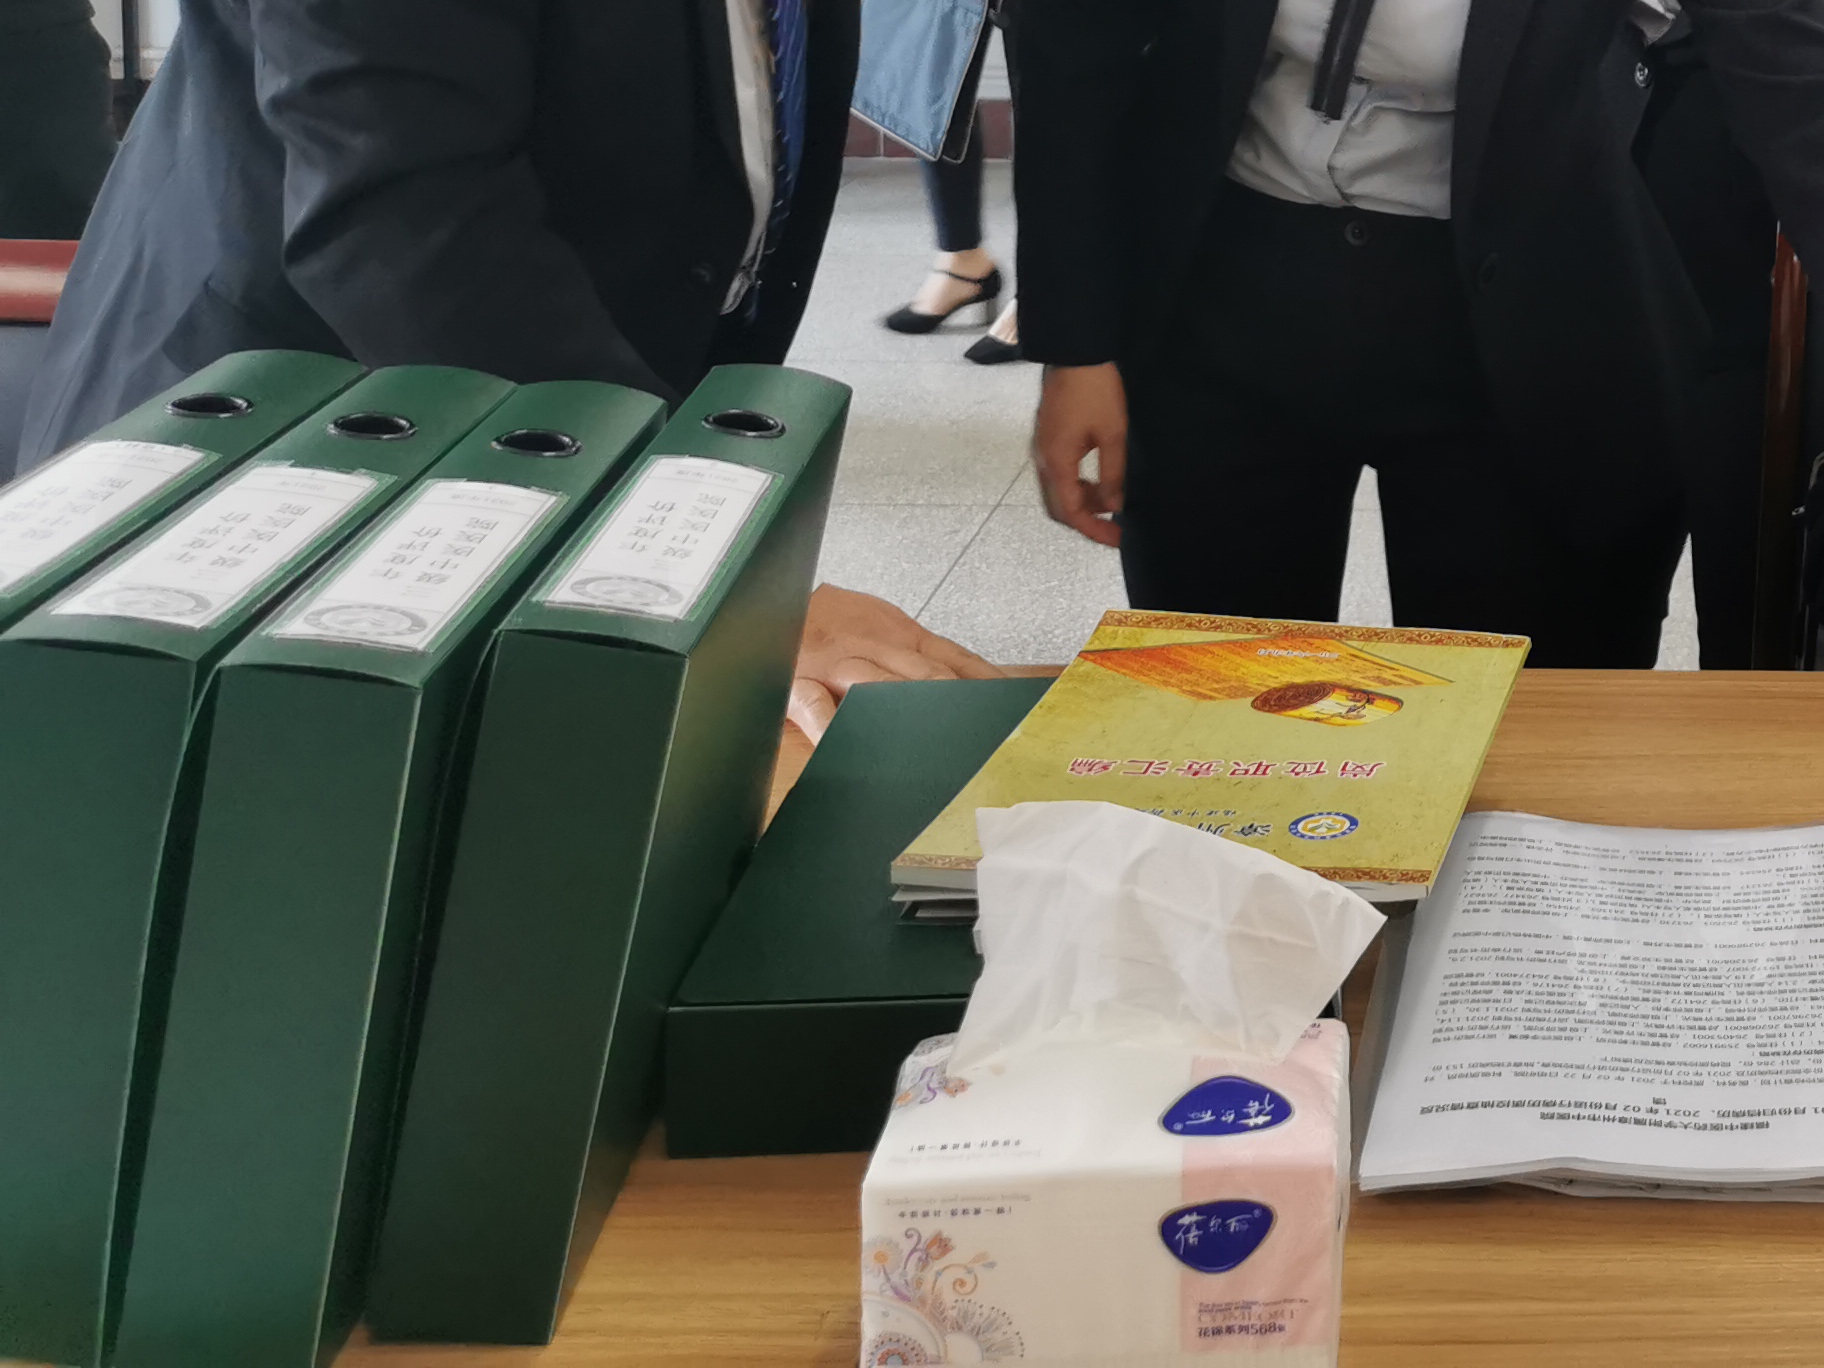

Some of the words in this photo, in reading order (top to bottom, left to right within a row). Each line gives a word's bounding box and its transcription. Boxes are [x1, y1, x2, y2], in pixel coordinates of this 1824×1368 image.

[167, 511, 252, 565] 年度评价
[190, 501, 313, 581] 三级中医医院
[371, 525, 443, 582] 年度评价
[618, 500, 678, 556] 年度评价
[651, 491, 728, 573] 三级中医医院
[400, 515, 500, 598] 三级中医医院
[1069, 757, 1385, 780] 岗位职责汇编
[1538, 1110, 1772, 1134] 福建中医药大学附属漳州市中医院
[1664, 1107, 1702, 1118] 2021
